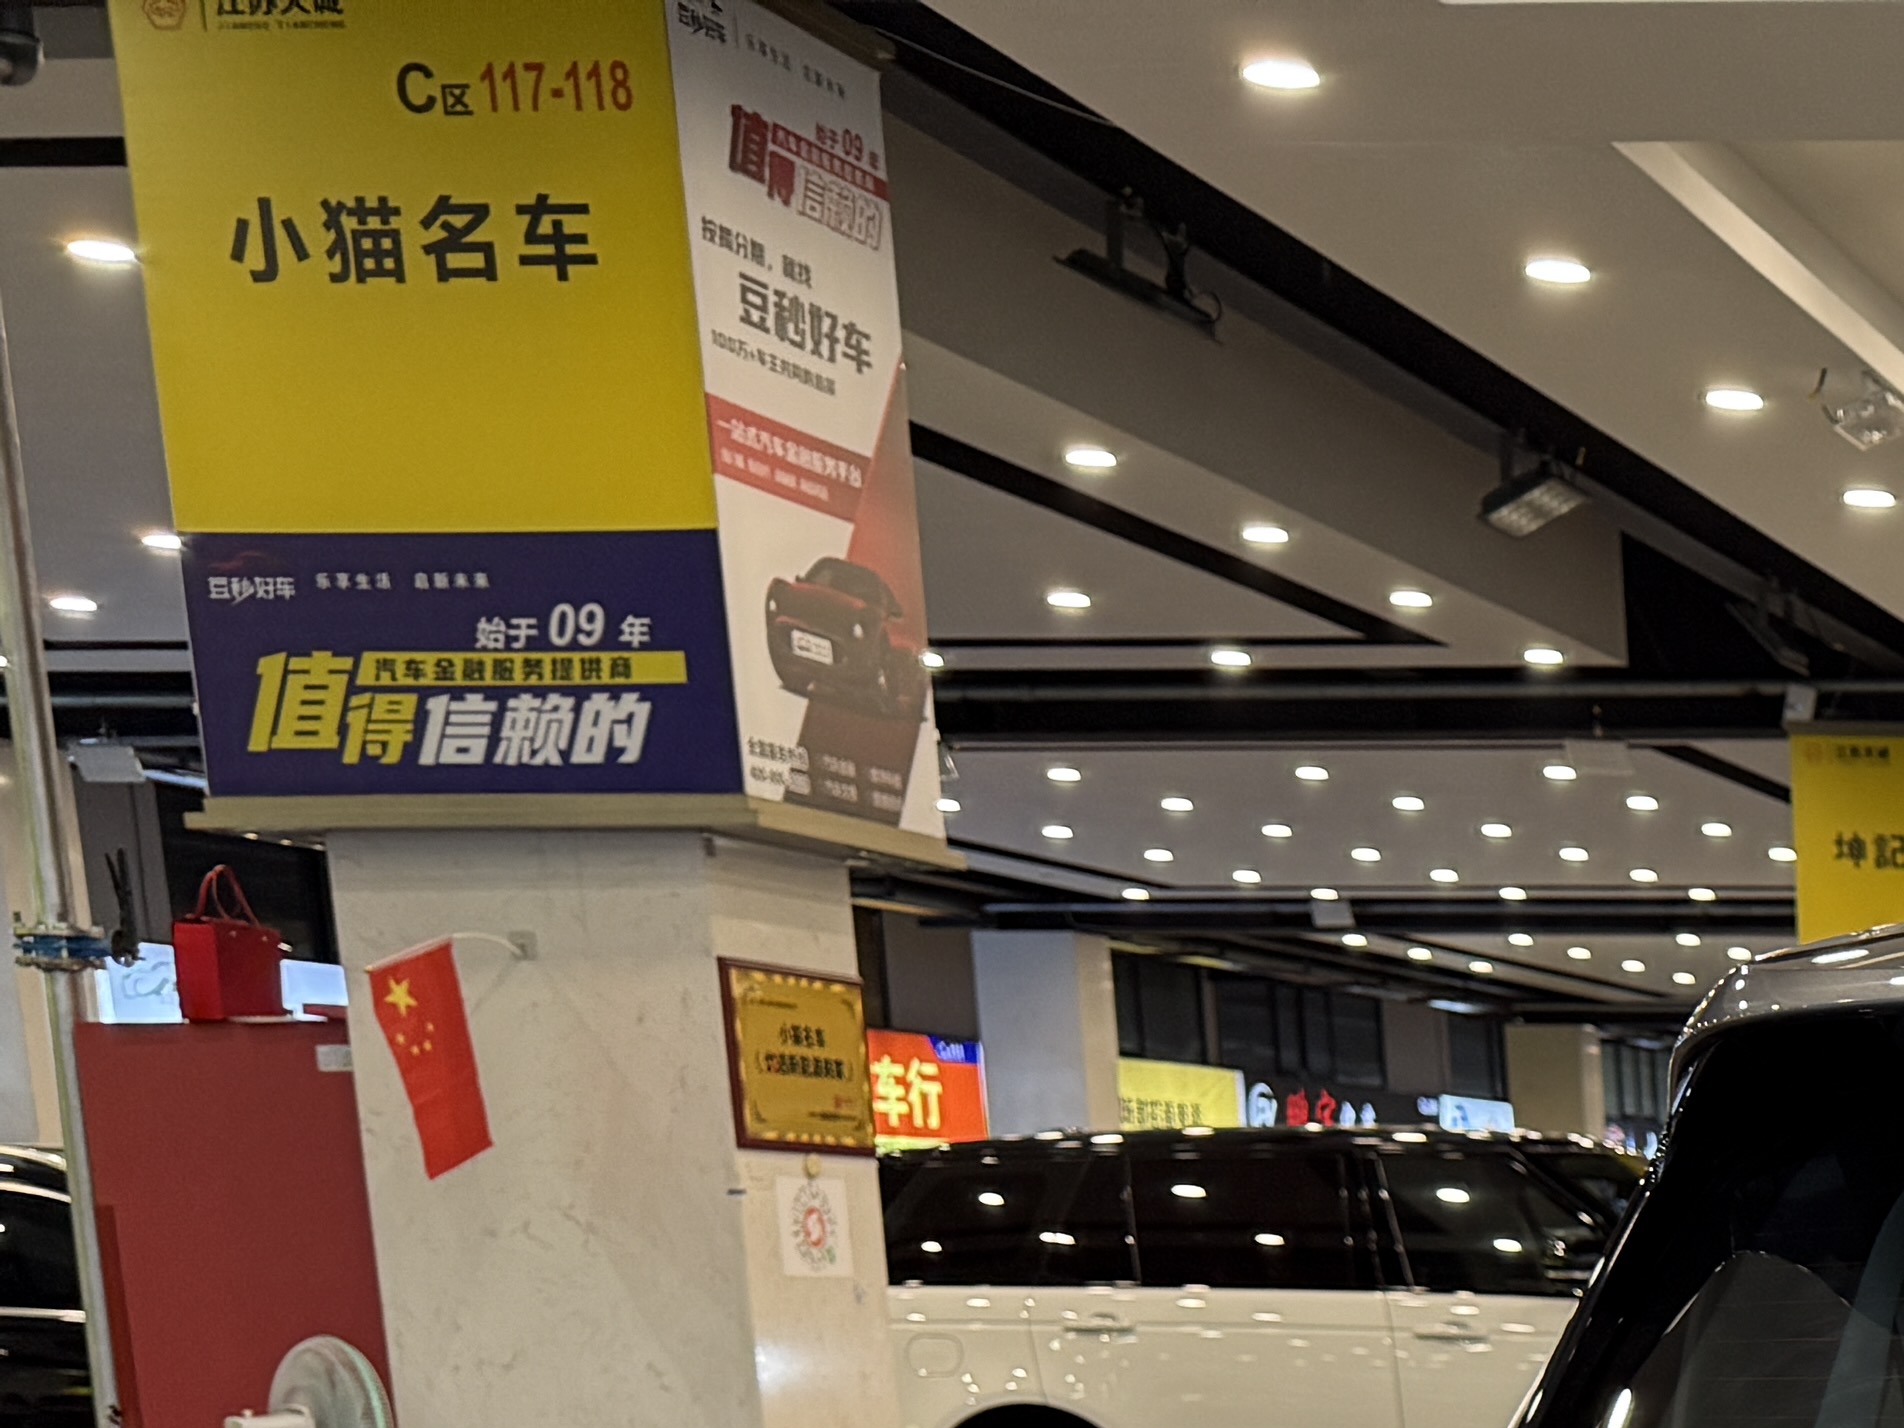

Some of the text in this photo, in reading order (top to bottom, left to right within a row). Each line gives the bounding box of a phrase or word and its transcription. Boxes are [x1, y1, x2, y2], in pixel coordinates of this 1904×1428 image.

[397, 60, 634, 116] C区 117-118
[842, 127, 864, 161] 09
[230, 193, 599, 285] 小猫名车
[474, 603, 653, 651] 始于 09 年
[374, 656, 633, 682] 汽车金融服务提供商
[247, 650, 652, 767] 值得信赖的
[869, 1054, 943, 1130] 车行
